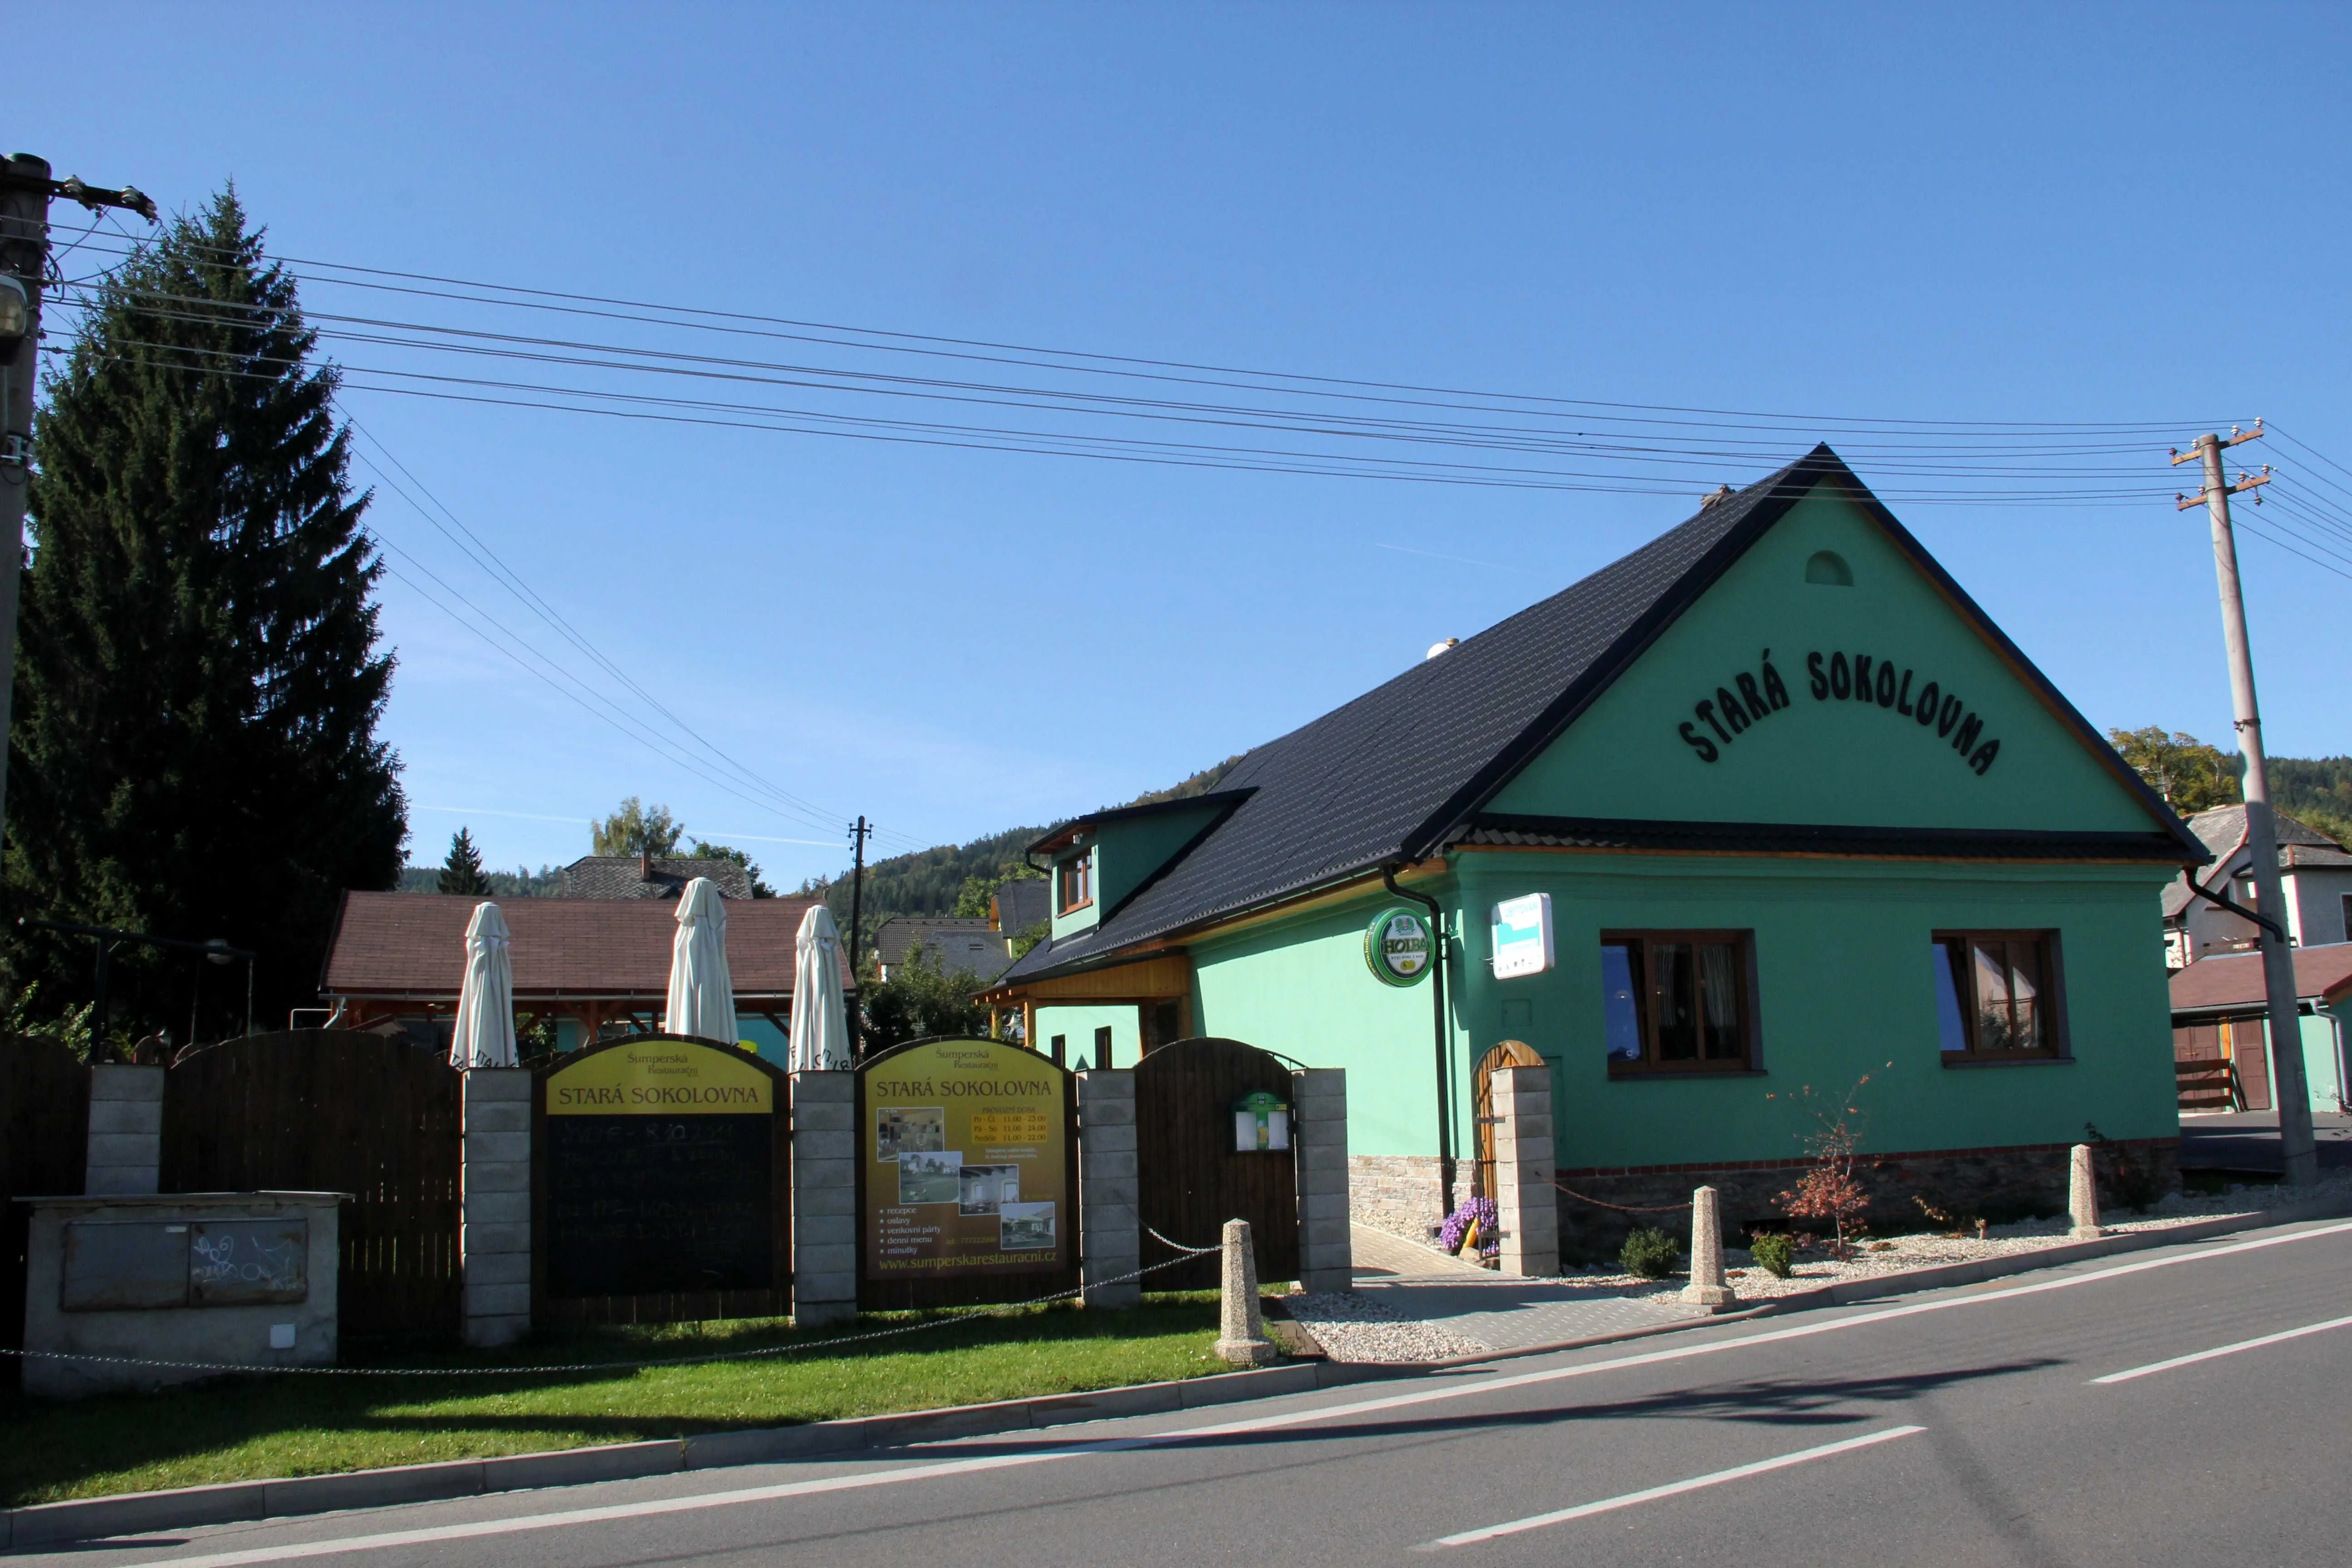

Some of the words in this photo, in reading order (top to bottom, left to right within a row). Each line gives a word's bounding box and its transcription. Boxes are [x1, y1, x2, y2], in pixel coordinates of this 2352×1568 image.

[1679, 648, 1790, 764] STARÁ
[1807, 651, 2000, 776] SOKOLOVNA
[1382, 937, 1431, 954] HOLBA
[627, 1052, 687, 1064] Šumperská
[936, 1048, 989, 1059] Šumperská
[954, 1060, 998, 1069] Restaurační
[877, 1077, 934, 1097] STARÁ
[941, 1081, 1051, 1096] SOKOLOVNA
[559, 1083, 624, 1104] STARÁ
[631, 1087, 758, 1104] SOKOLOVNA
[887, 1217, 911, 1225] oslavy
[887, 1225, 920, 1234] venkovní
[922, 1225, 941, 1234] párty
[887, 1246, 918, 1255] minutky
[879, 1252, 1057, 1270] www.sumperskarestauracni.cz
